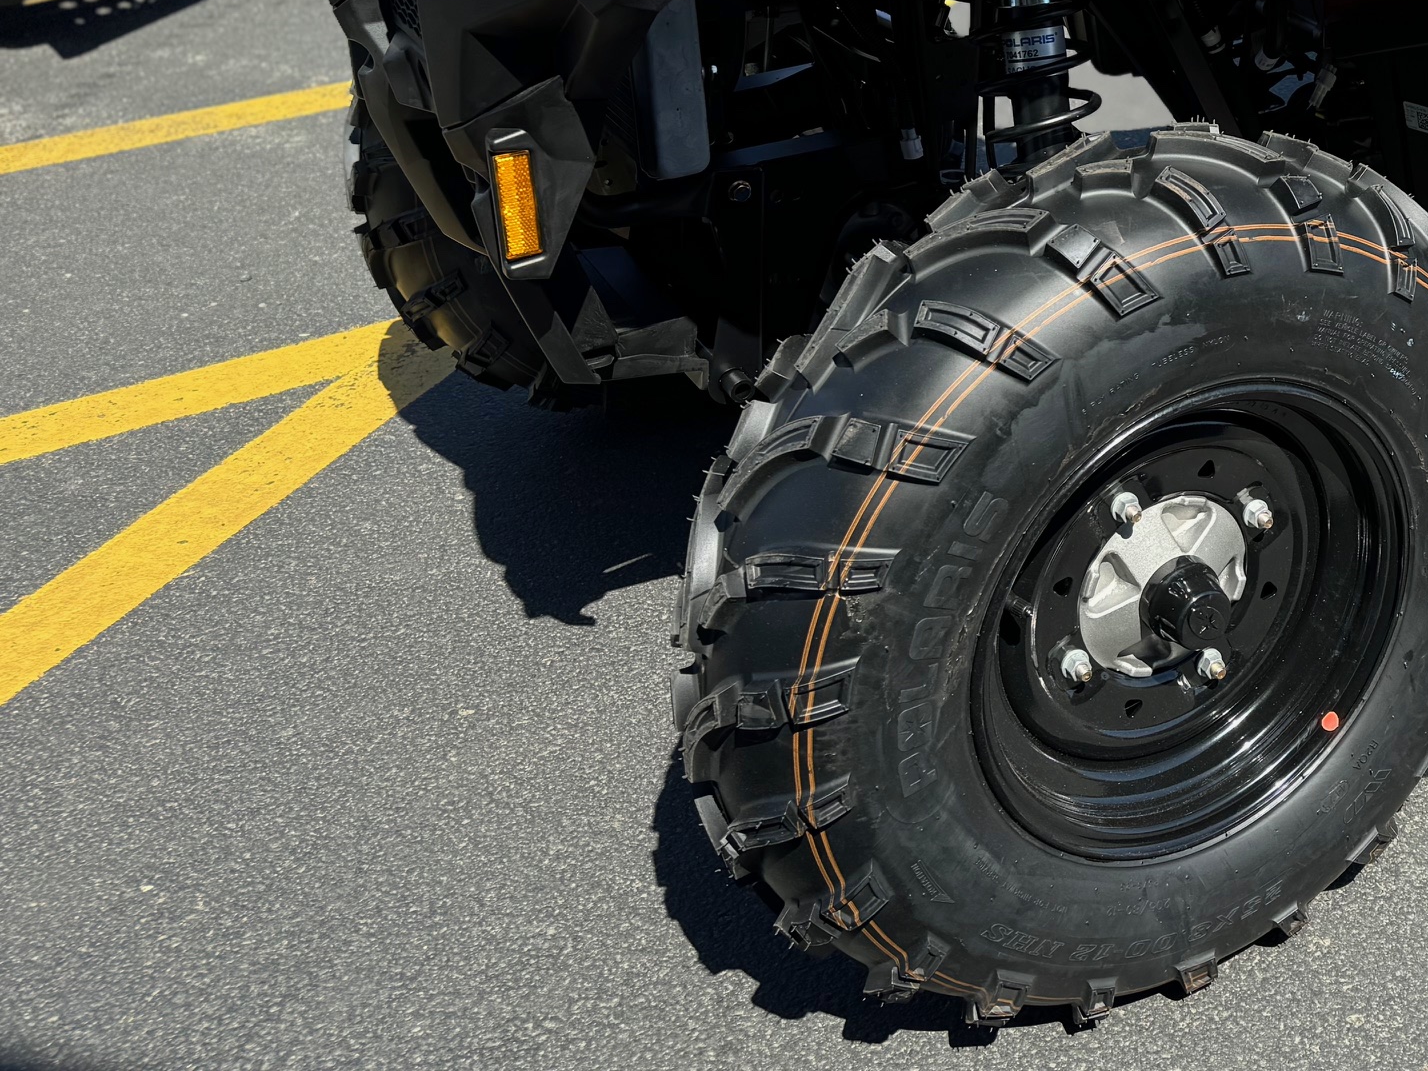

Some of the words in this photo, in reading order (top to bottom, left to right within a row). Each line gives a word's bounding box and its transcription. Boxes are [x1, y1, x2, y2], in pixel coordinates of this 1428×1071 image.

[1151, 345, 1194, 367] TUBELESS
[897, 490, 1009, 799] POLARIS
[910, 863, 938, 896] ROTATION
[979, 923, 1066, 960] NHS
